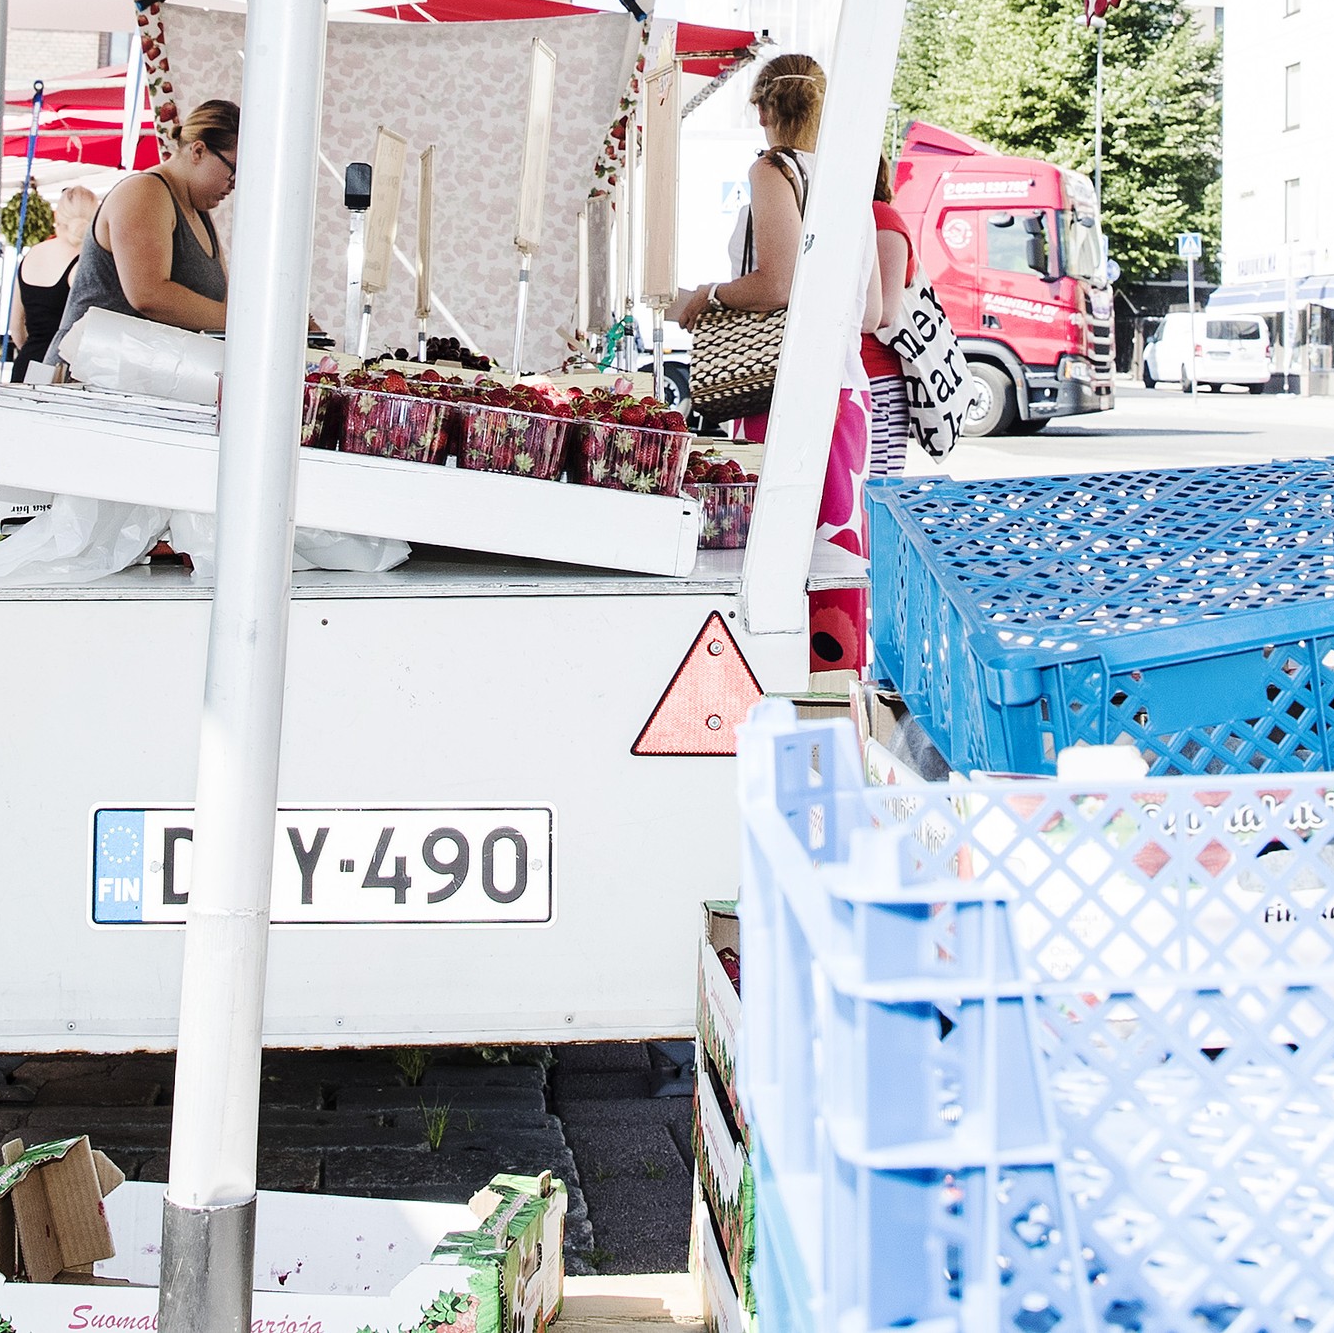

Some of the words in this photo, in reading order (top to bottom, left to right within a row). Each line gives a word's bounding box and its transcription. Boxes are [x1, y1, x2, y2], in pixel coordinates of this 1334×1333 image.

[904, 329, 961, 409] mar
[98, 877, 140, 903] FIN
[162, 825, 528, 904] DY-490
[67, 1304, 159, 1331] Suomal
